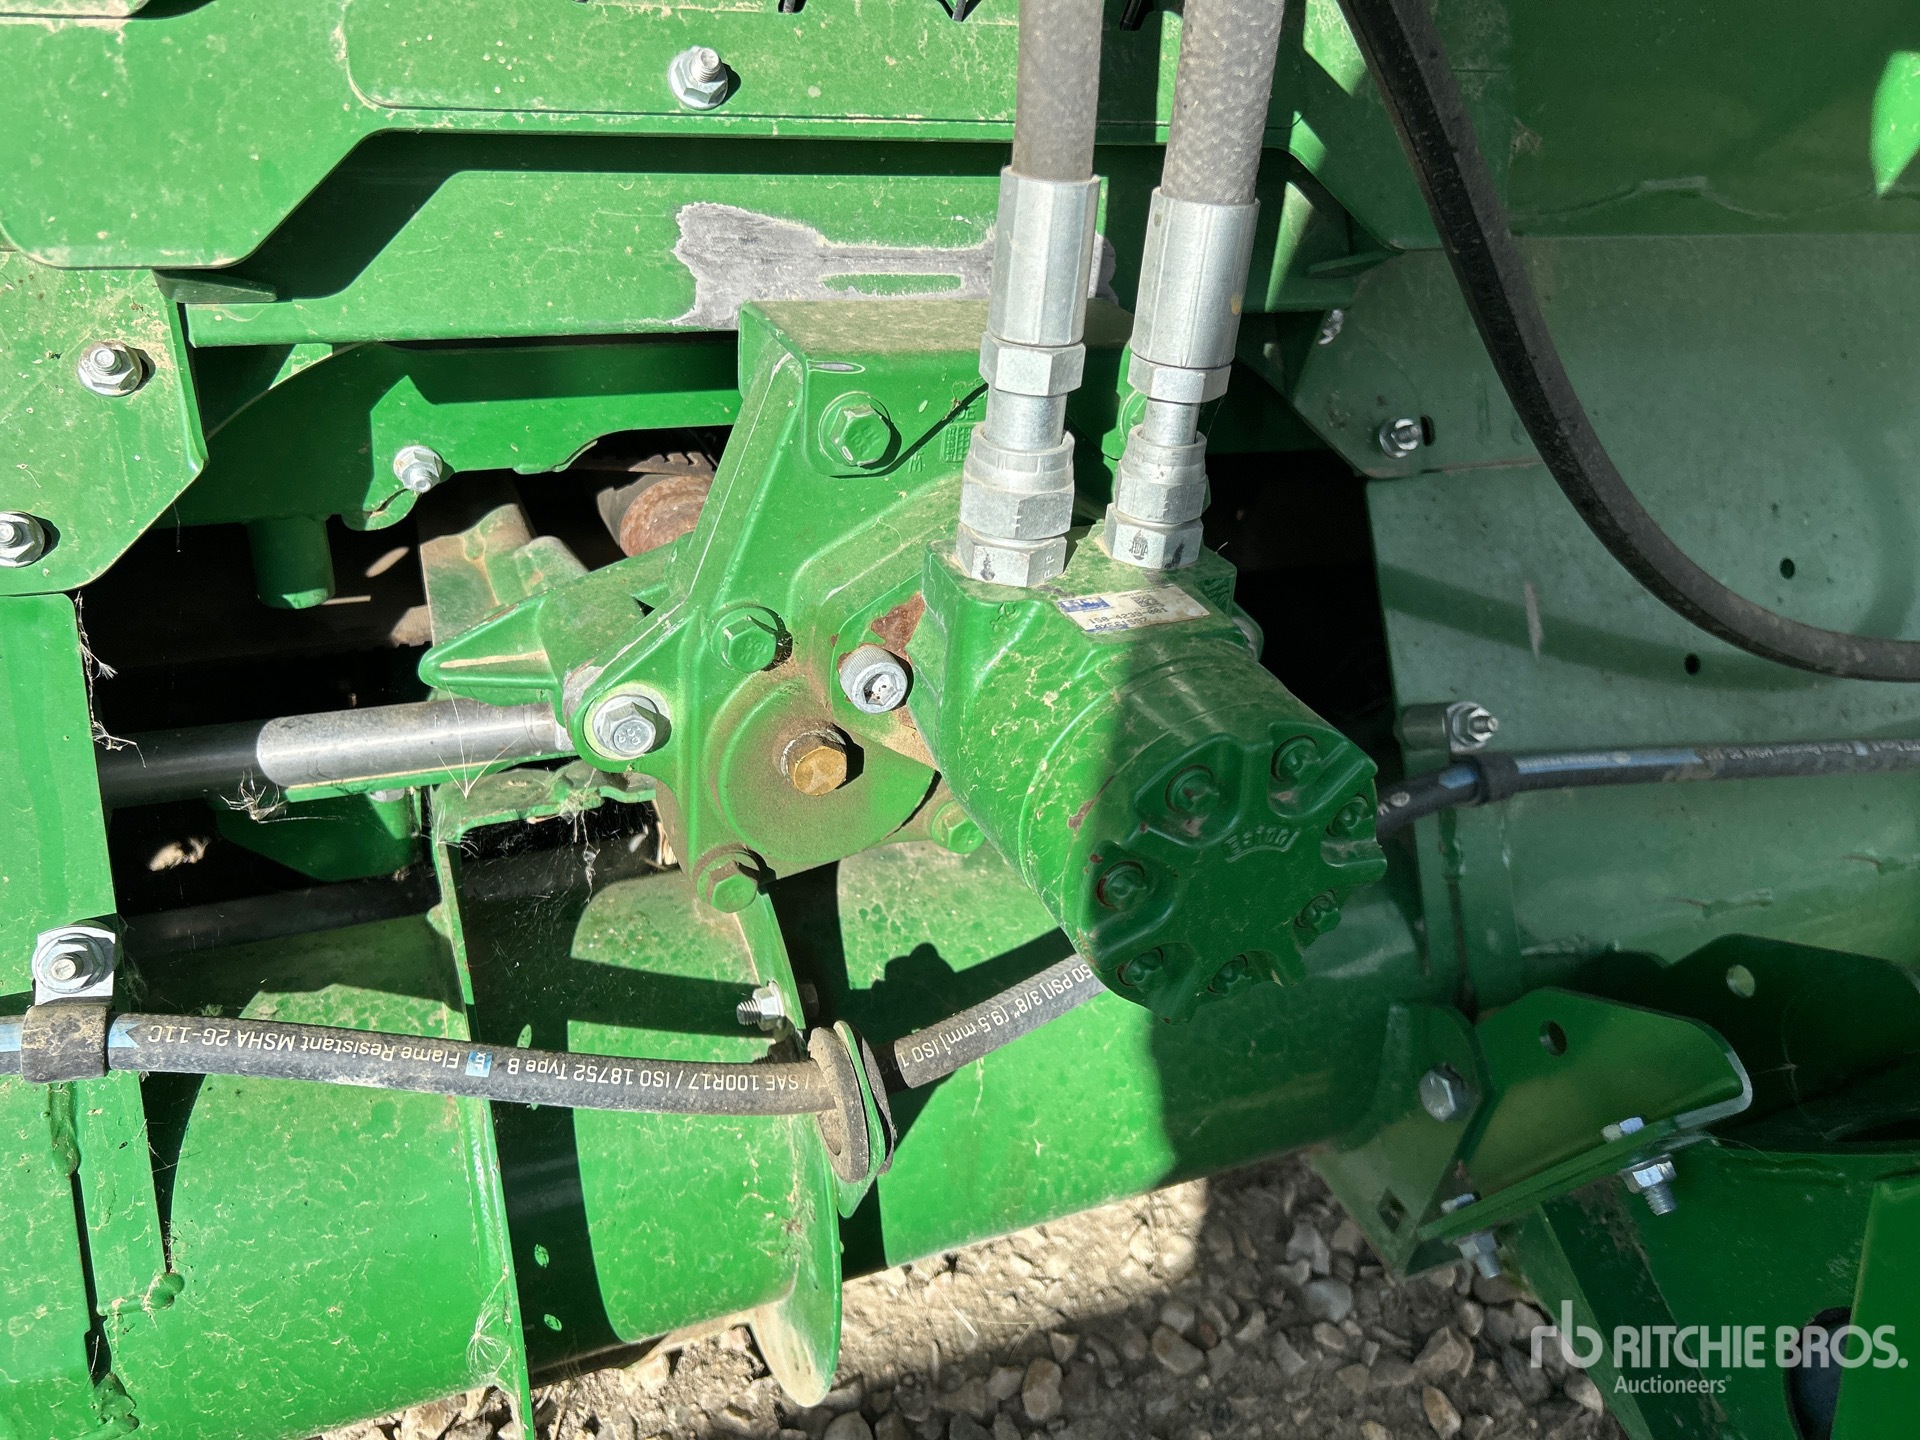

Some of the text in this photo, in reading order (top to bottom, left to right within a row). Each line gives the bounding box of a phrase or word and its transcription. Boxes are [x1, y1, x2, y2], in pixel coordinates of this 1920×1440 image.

[237, 1029, 296, 1051] MSHA
[300, 1036, 396, 1062] Resistant
[401, 1046, 460, 1069] Flame
[911, 1041, 940, 1063] ISO
[507, 1058, 521, 1075] B
[525, 1058, 568, 1080] Type
[573, 1062, 634, 1085] 18752
[640, 1069, 670, 1089] ISO
[688, 1072, 759, 1091] 100R17
[765, 1073, 800, 1091] SAE
